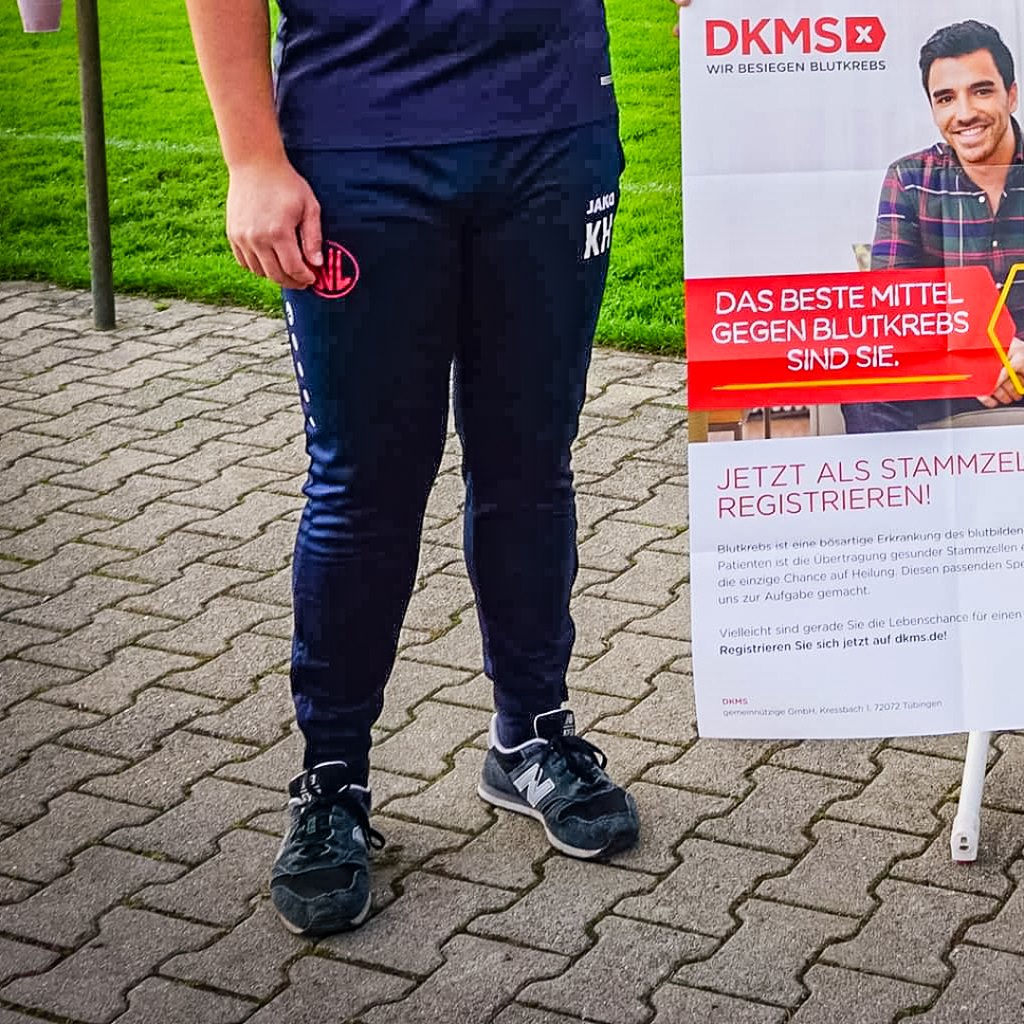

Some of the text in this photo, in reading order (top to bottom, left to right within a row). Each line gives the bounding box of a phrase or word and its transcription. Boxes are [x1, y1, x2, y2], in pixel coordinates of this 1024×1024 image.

[705, 17, 842, 56] DKMS
[706, 60, 886, 75] WIR BESIEGEN BLUTKREBS
[586, 191, 615, 215] JAKO
[583, 212, 613, 260] KH
[716, 281, 964, 315] DAS BESTE MITTEL
[711, 310, 969, 344] GEGEN BLUTKREBS
[787, 344, 900, 371] SIND SIE.
[716, 463, 806, 491] JETZT
[816, 459, 871, 484] ALS
[718, 484, 932, 519] REGISTRIEREN!
[717, 542, 772, 554] Blutkrebs
[775, 541, 789, 550] ist
[792, 540, 816, 549] eine
[820, 534, 873, 547] bösartige
[877, 531, 941, 544] Erkrankung
[945, 529, 964, 539] des
[718, 559, 772, 571] Patienten
[775, 557, 789, 567] ist
[792, 556, 810, 566] die
[814, 552, 887, 565] Übertragung
[891, 547, 943, 562] gesunder
[946, 542, 1018, 556] Stammzellen
[718, 576, 736, 588] die
[739, 574, 780, 587] einzige
[784, 571, 827, 584] Chance
[830, 570, 849, 580] auf
[901, 563, 939, 576] Diesen
[942, 560, 1002, 574] passenden
[718, 594, 739, 605] uns
[742, 592, 760, 603] zur
[764, 588, 814, 602] Aufgabe
[719, 626, 771, 638] Vielleicht
[775, 623, 799, 634] sind
[803, 620, 844, 635] gerade
[847, 619, 865, 630] Sie
[868, 617, 886, 629] die
[889, 611, 969, 628] Lebenschance
[972, 610, 987, 622] für
[991, 609, 1022, 620] einen
[719, 629, 948, 656] Registrieren Sie sich jetzt auf dkms.de!
[722, 697, 749, 705] DKMS
